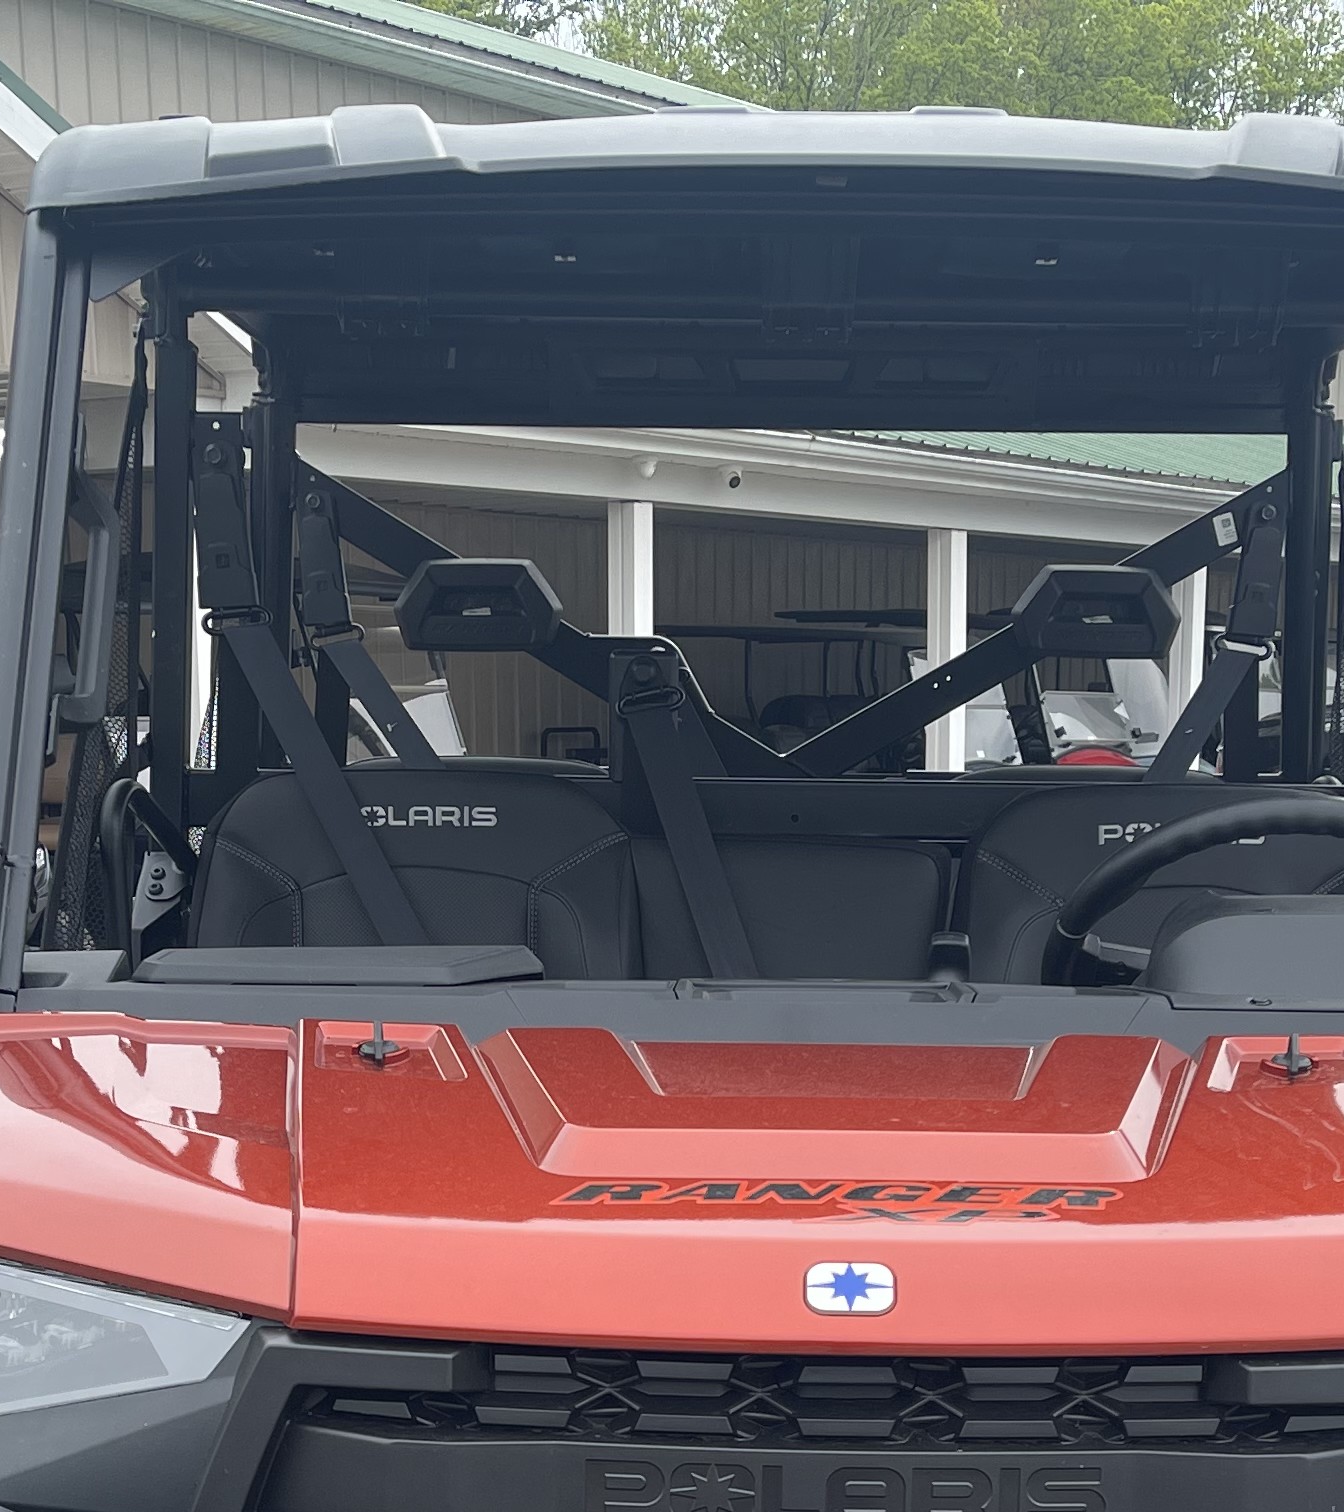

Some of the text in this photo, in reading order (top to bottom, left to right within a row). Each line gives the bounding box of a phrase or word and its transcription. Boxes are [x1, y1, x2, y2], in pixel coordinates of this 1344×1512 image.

[360, 806, 498, 827] OLARIS
[556, 1180, 1122, 1209] RANGER
[830, 1206, 1056, 1224] XP
